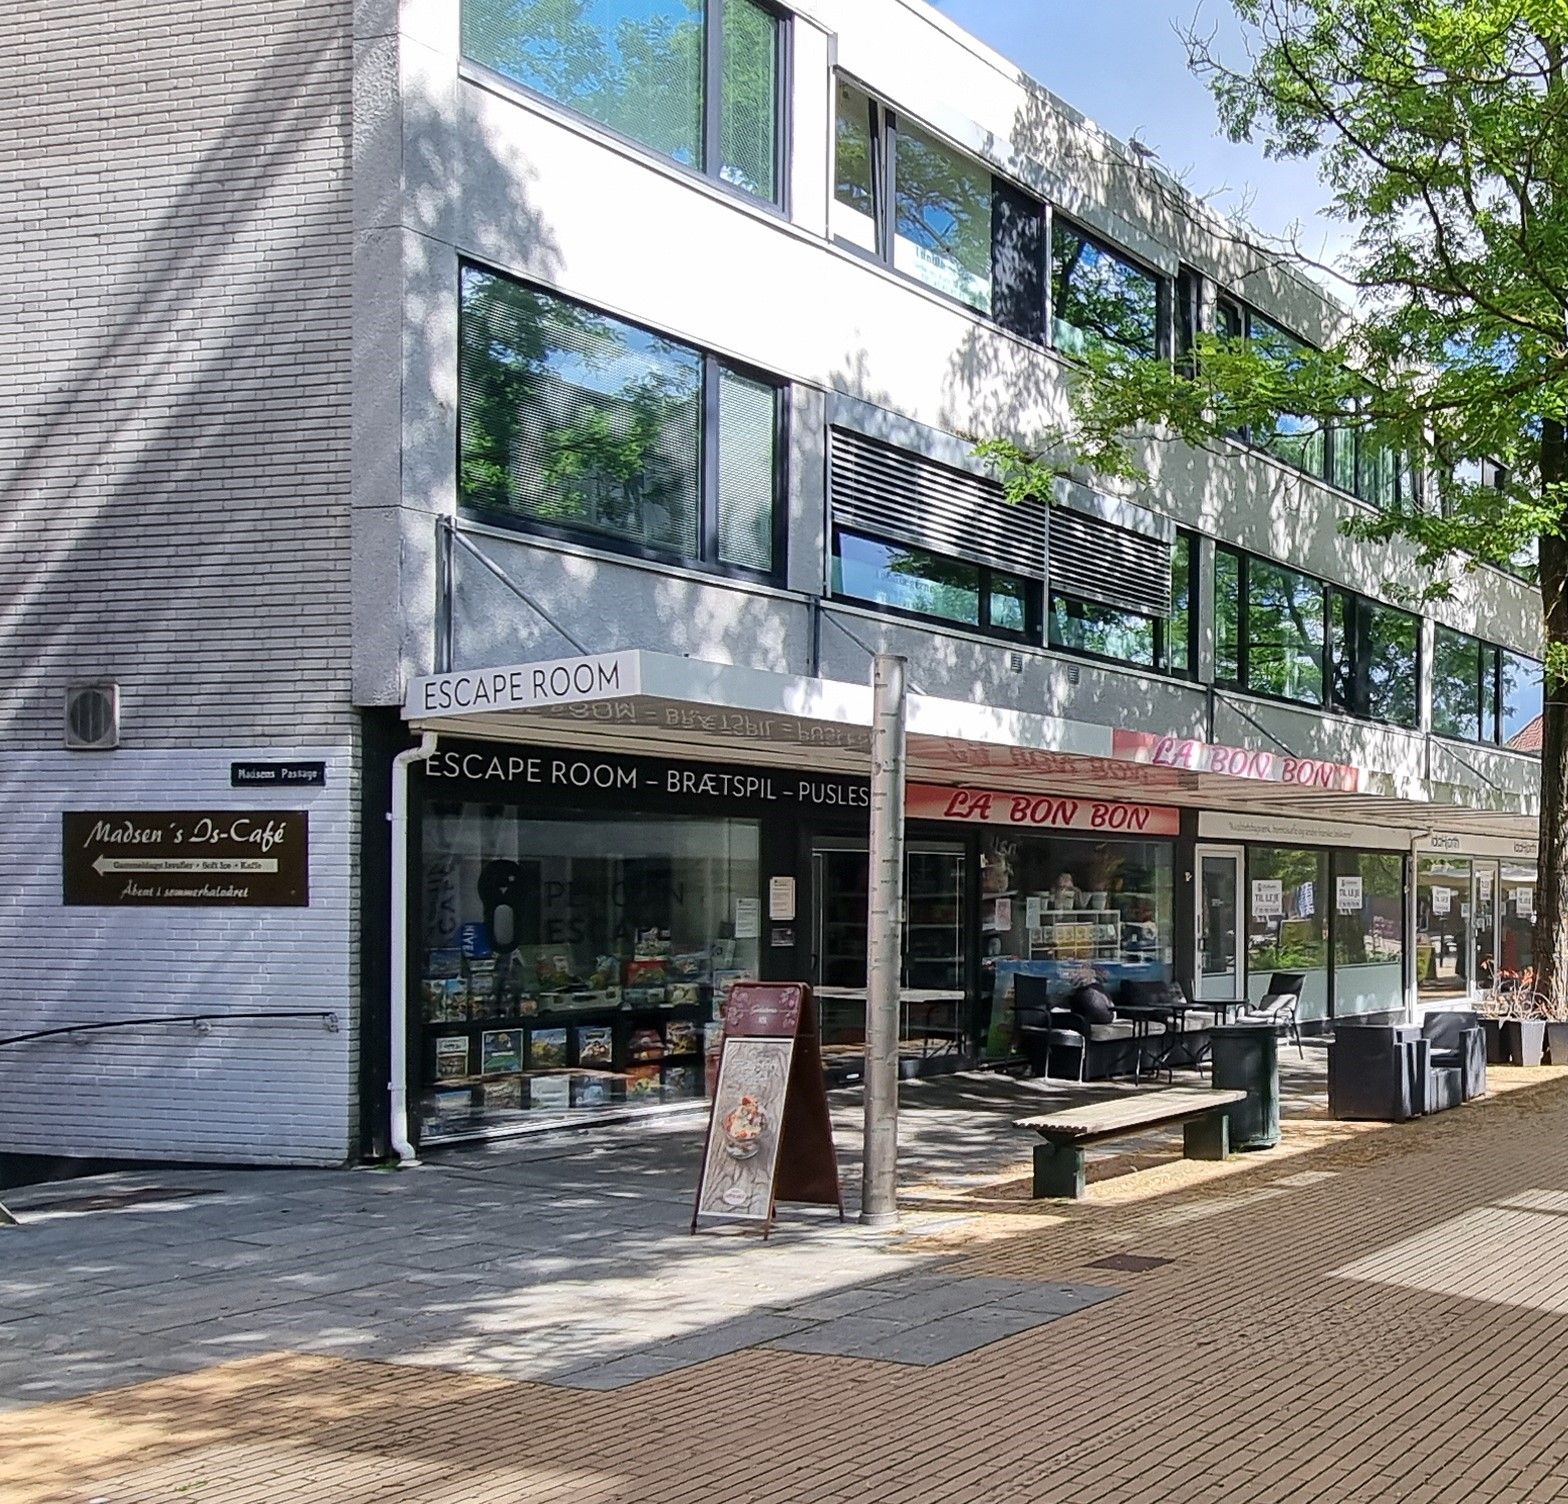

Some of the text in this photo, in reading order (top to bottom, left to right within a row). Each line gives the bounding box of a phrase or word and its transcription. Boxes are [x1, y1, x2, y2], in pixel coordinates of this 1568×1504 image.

[424, 660, 620, 710] ESCAPE ROOM
[281, 768, 318, 780] Passage
[426, 751, 541, 783] ESCAPE
[552, 761, 637, 789] ROOM
[667, 769, 777, 800] BRÆTSPIL
[1152, 736, 1193, 767] LA
[1210, 748, 1273, 778] BON
[1282, 757, 1336, 788] BON
[944, 791, 1150, 830] LA BON BON
